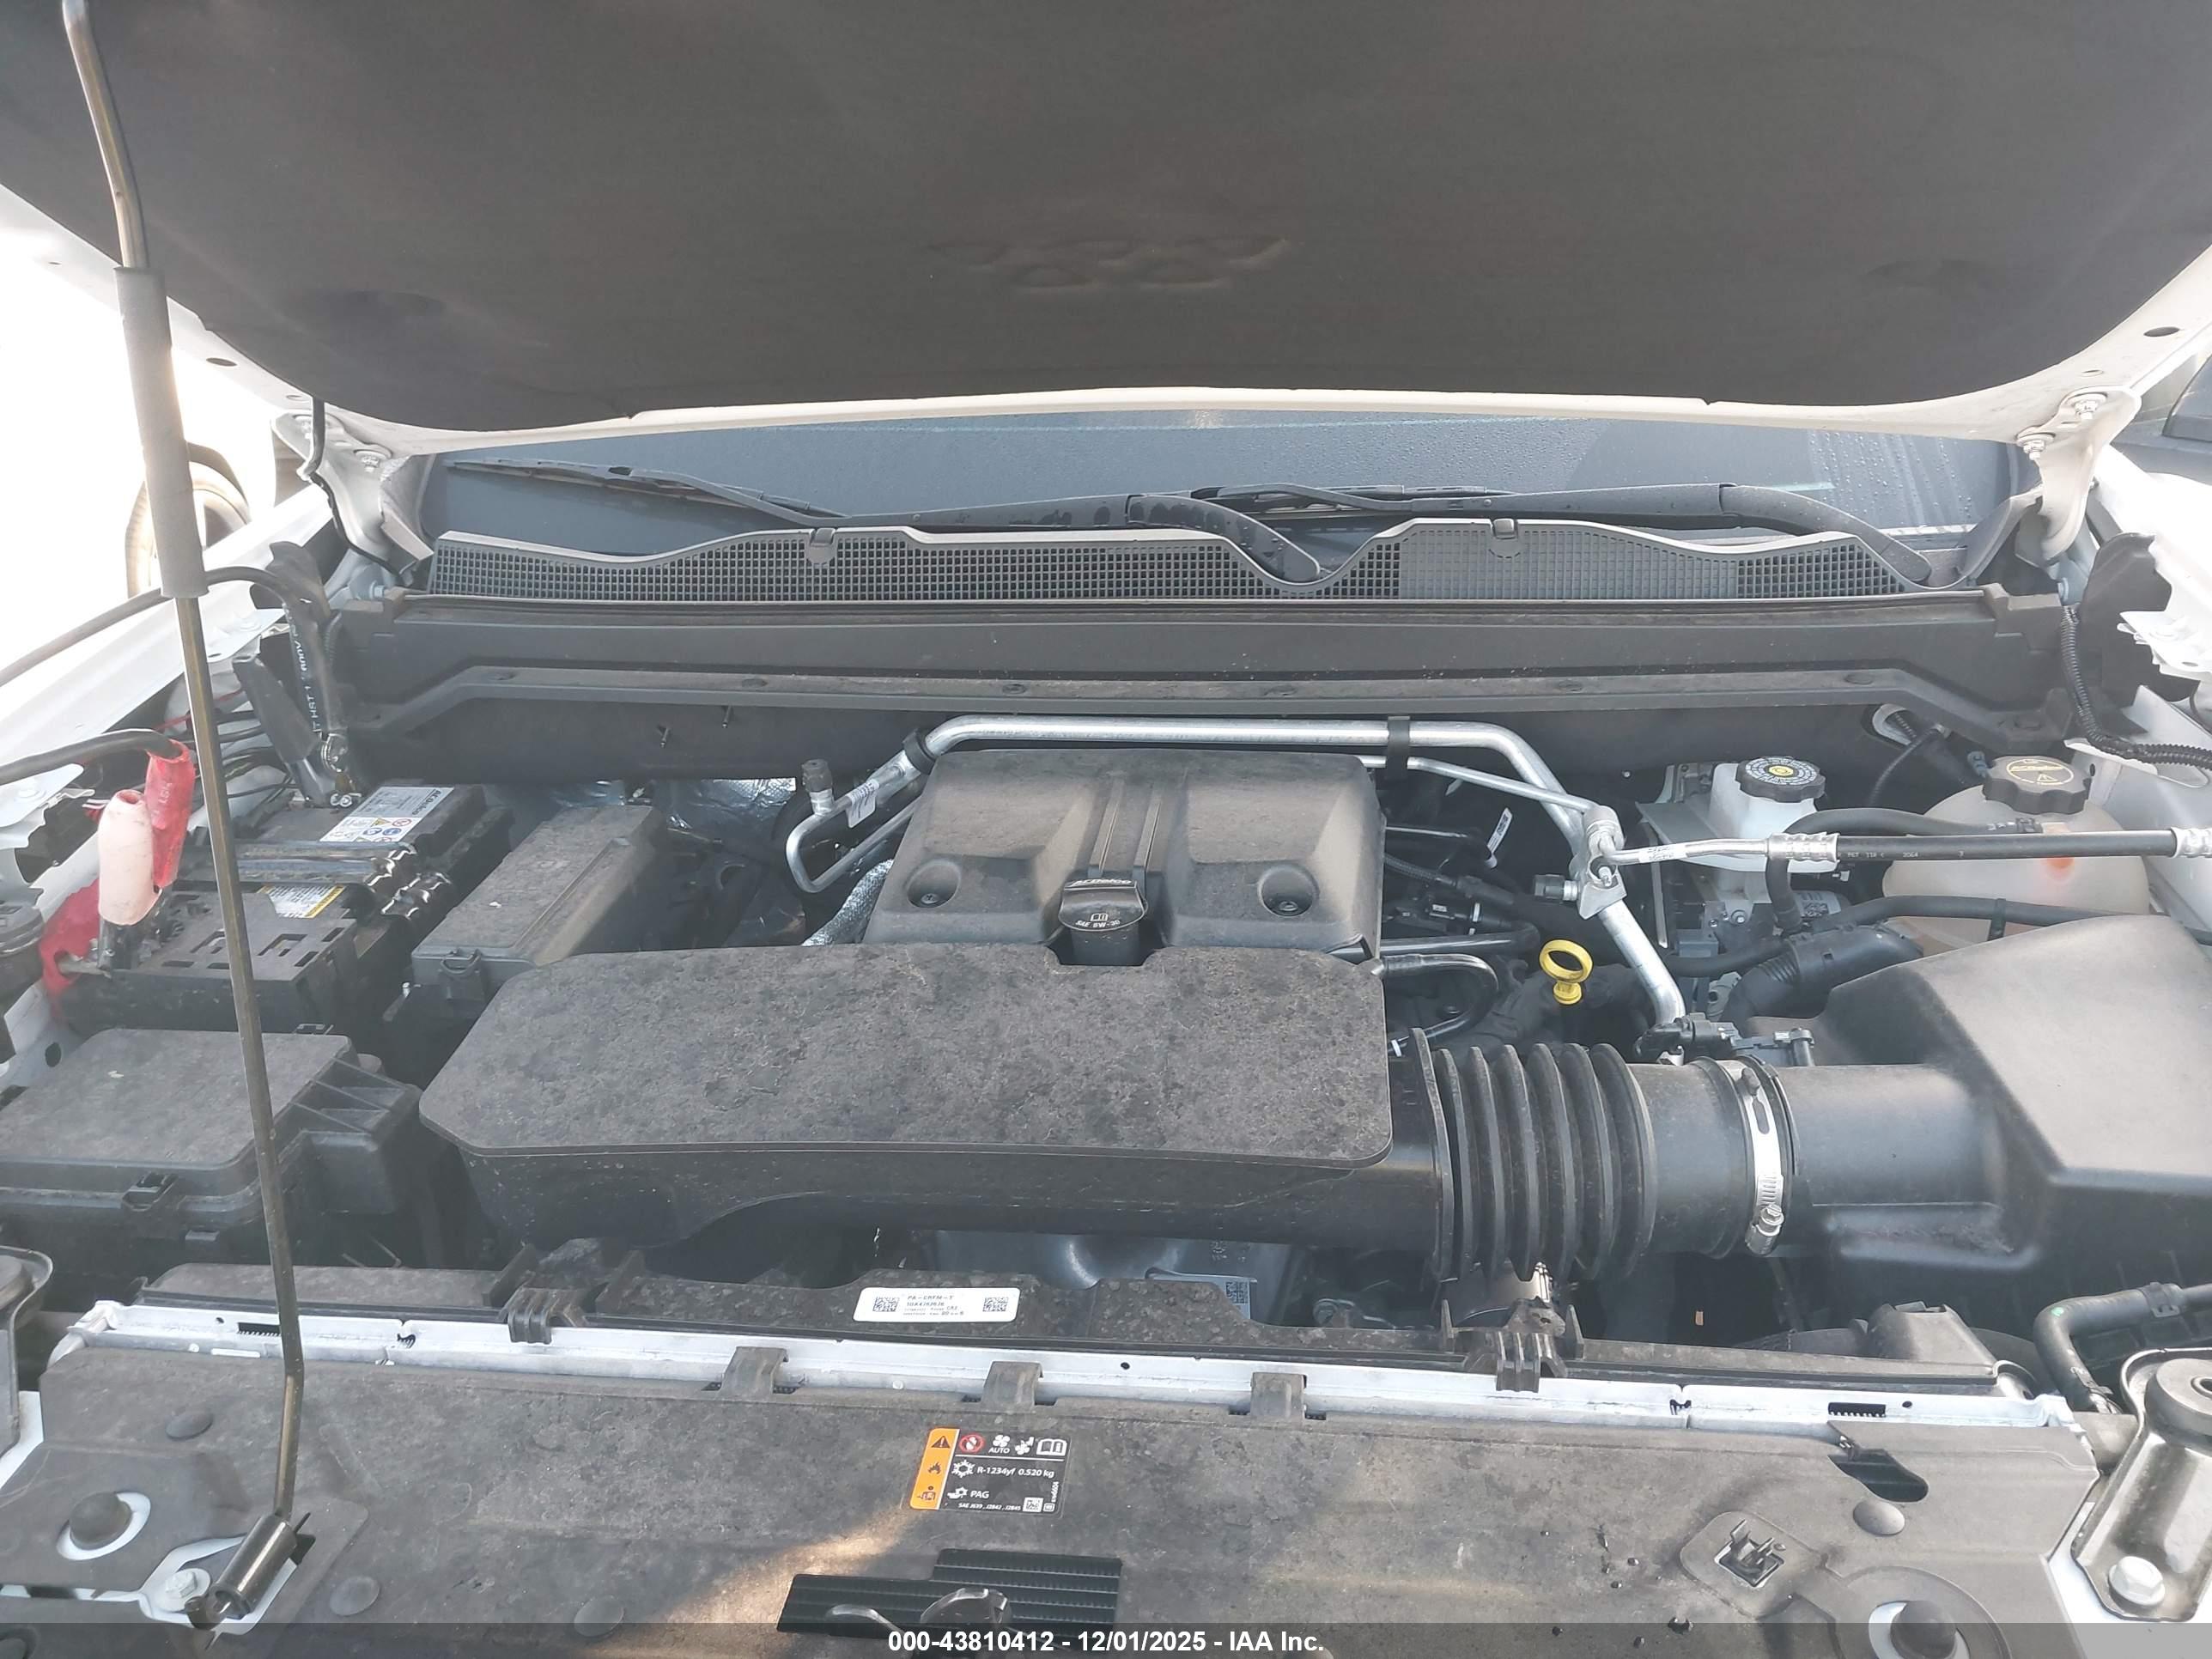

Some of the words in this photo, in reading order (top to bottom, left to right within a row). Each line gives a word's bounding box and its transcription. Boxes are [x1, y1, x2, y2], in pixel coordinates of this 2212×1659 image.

[976, 1467, 1016, 1476] R-1234yf
[1018, 1468, 1042, 1476] 0.520
[1042, 1469, 1054, 1478] kg
[969, 1490, 990, 1498] PAG
